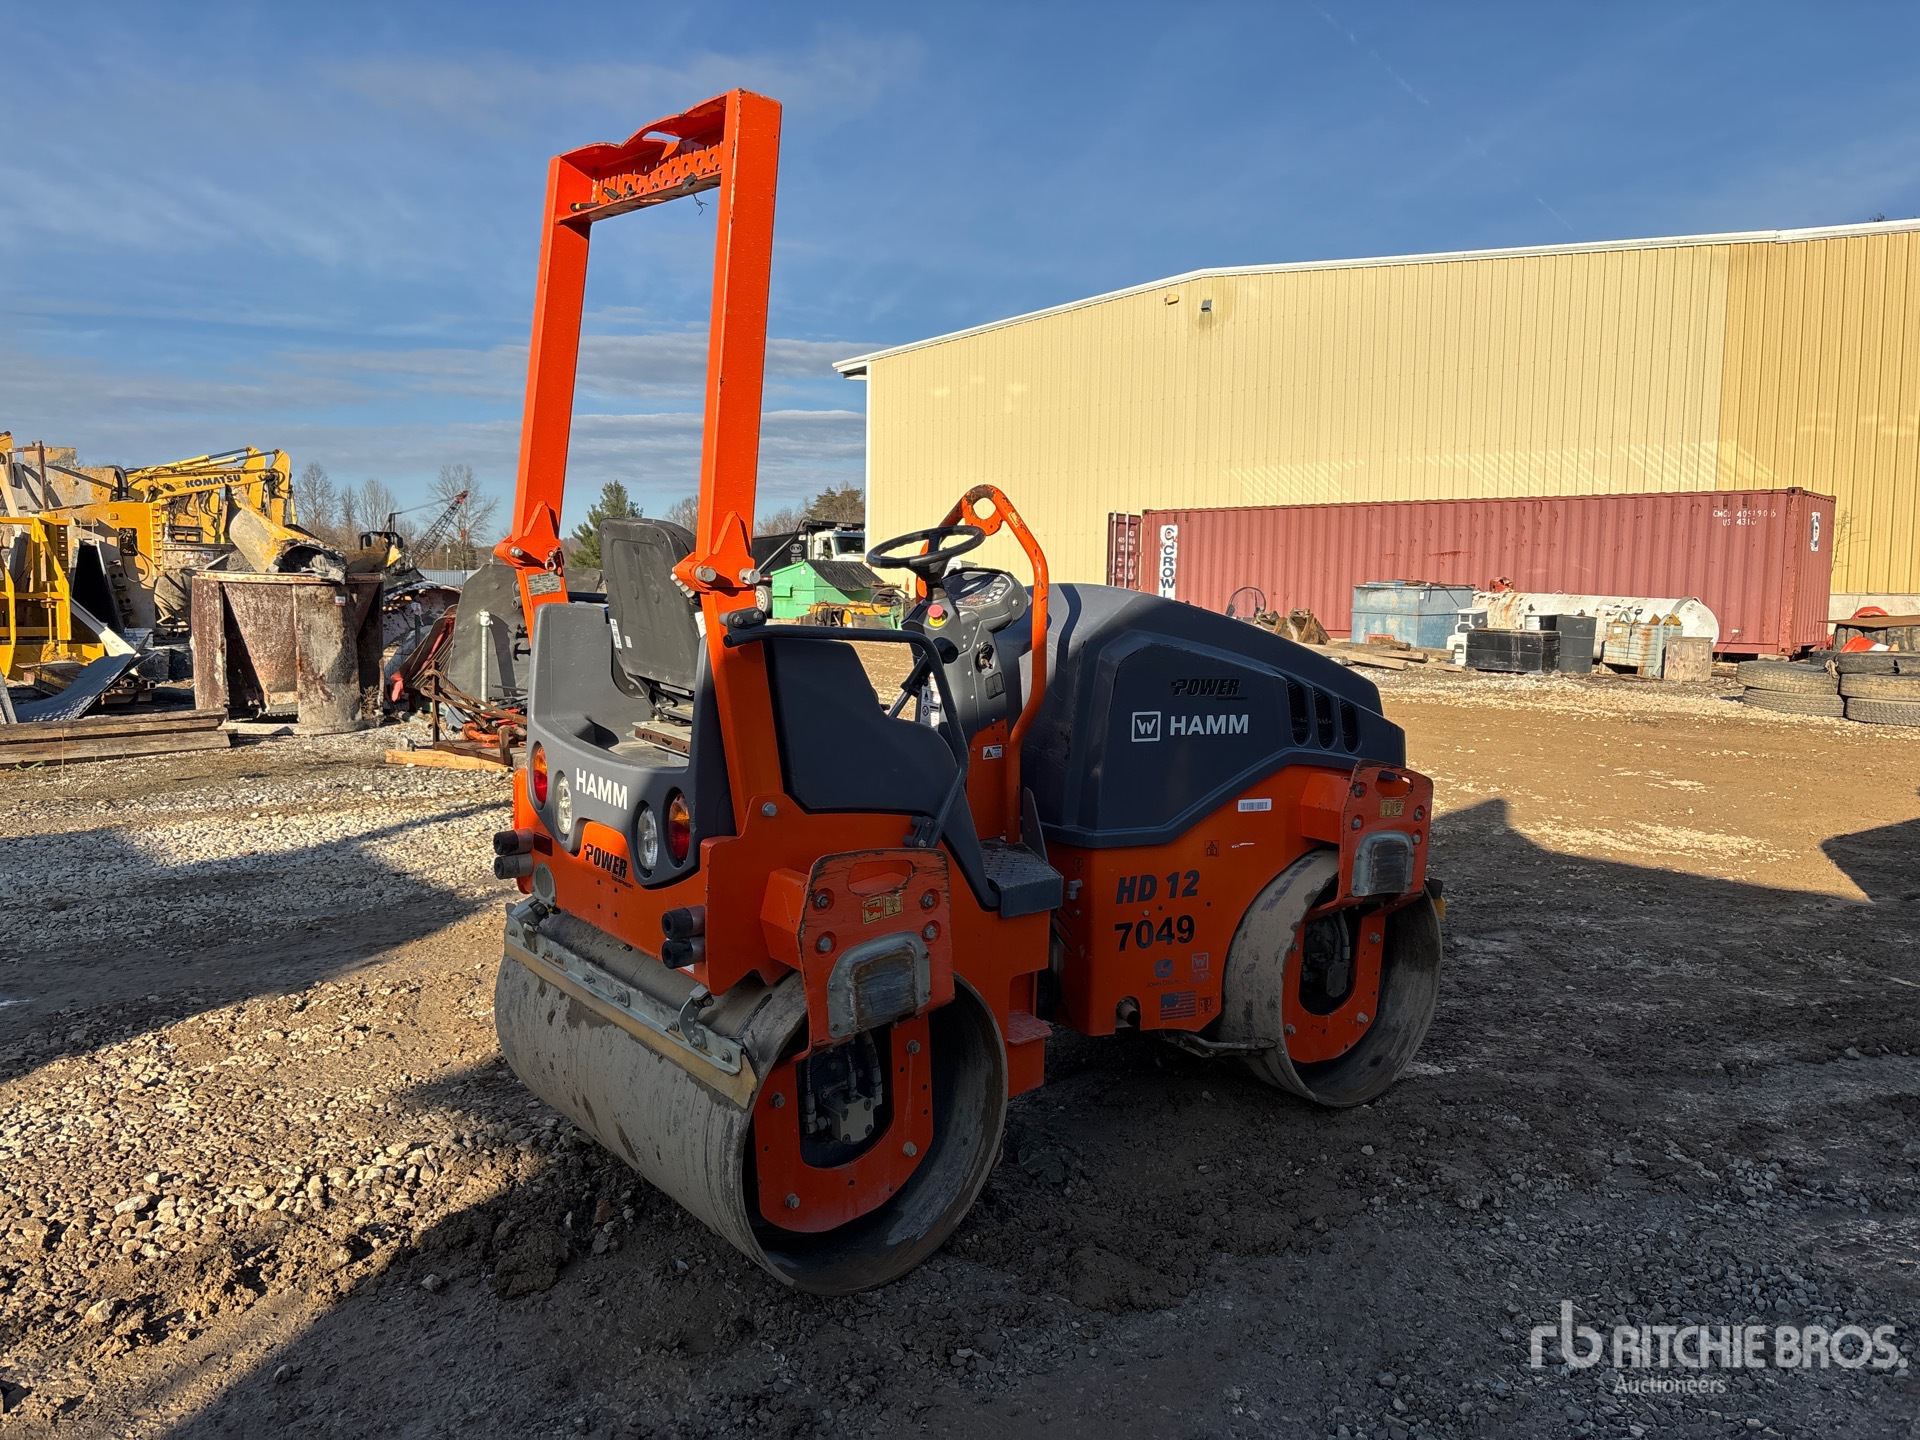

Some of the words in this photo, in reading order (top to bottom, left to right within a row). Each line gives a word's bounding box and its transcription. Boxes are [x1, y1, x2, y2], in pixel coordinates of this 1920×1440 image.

[185, 474, 242, 488] KOMATSU
[1171, 679, 1241, 697] POWER
[1169, 714, 1250, 736] HAMM
[575, 767, 628, 811] HAMM
[584, 843, 628, 879] POWER
[1115, 874, 1158, 905] HD
[1166, 869, 1200, 899] 12
[1114, 914, 1196, 952] 7049
